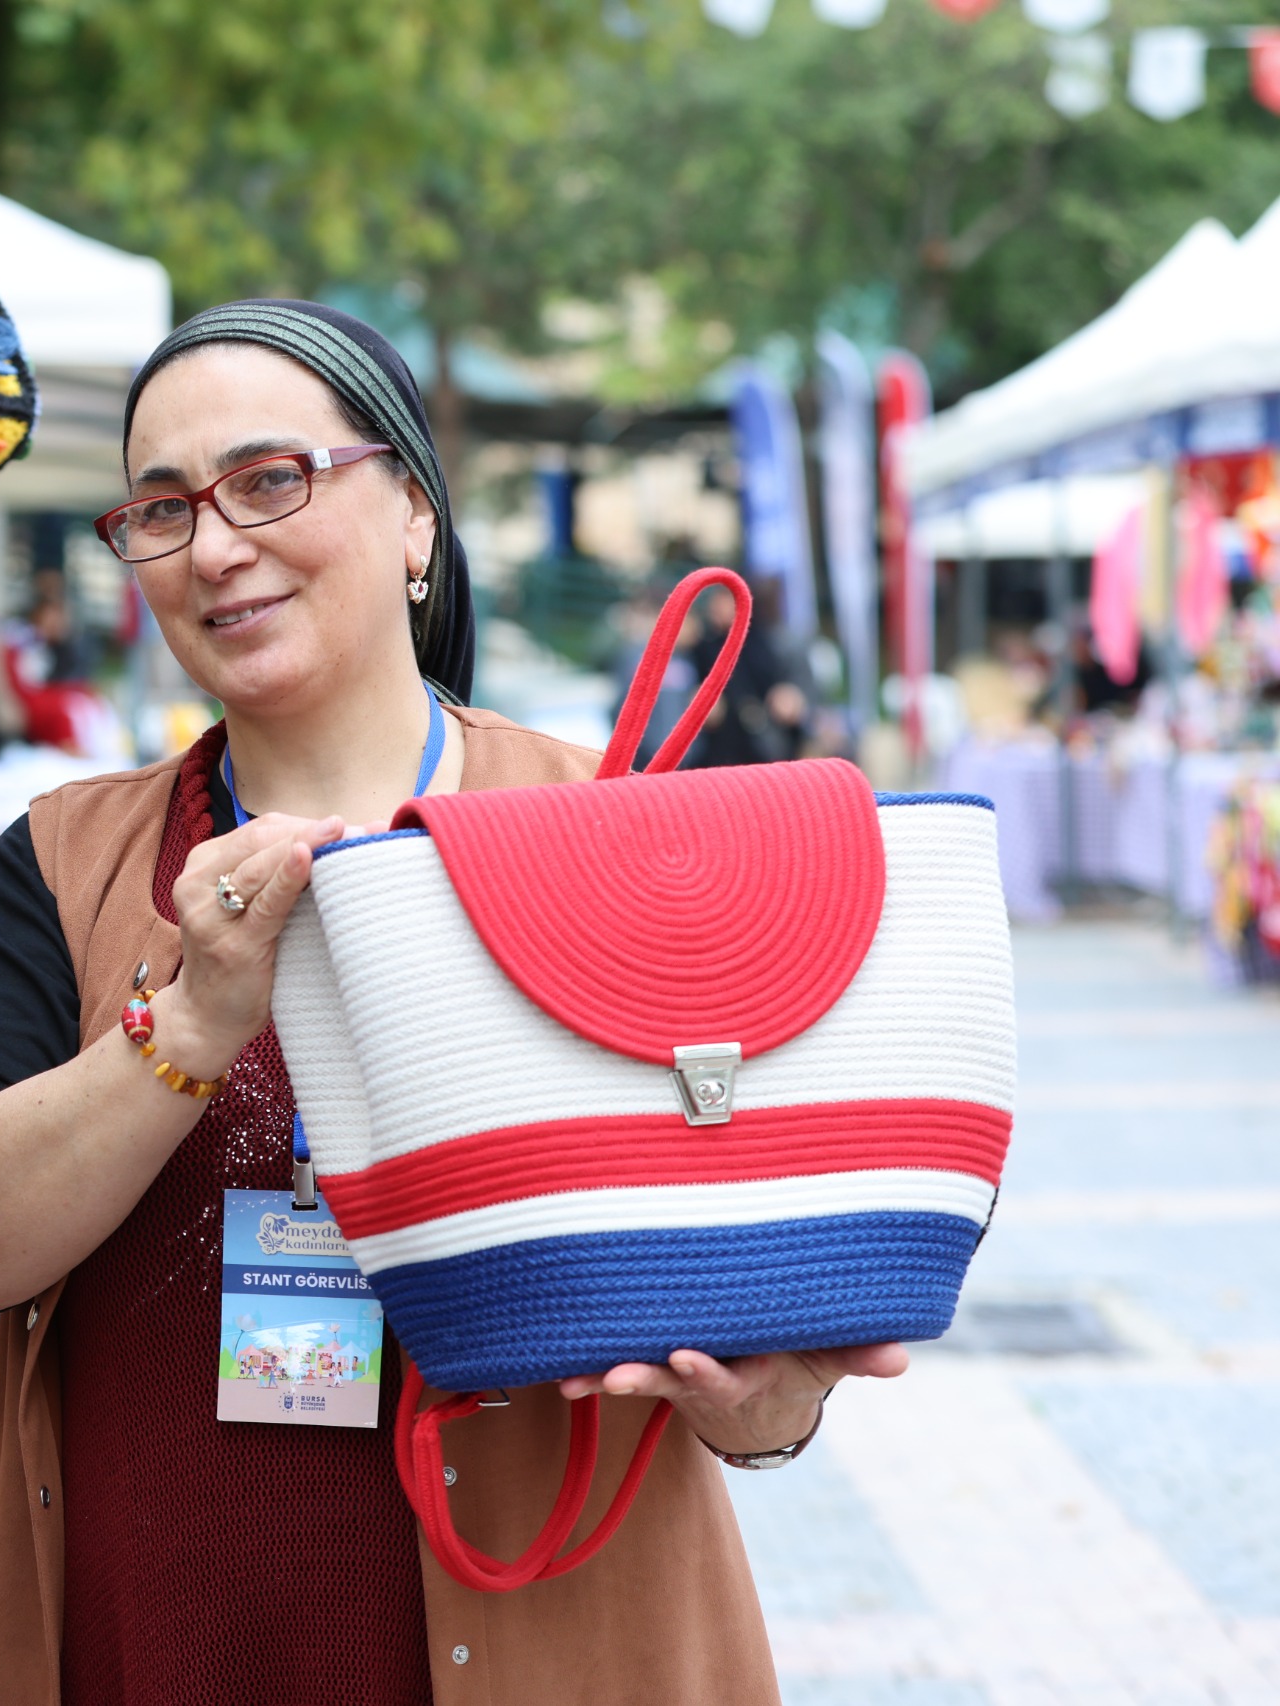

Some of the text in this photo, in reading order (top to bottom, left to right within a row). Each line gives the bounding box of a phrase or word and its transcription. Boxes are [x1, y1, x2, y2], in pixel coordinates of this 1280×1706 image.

[285, 1239, 350, 1252] kadınları
[242, 1272, 372, 1290] STANT GÖREVLİS
